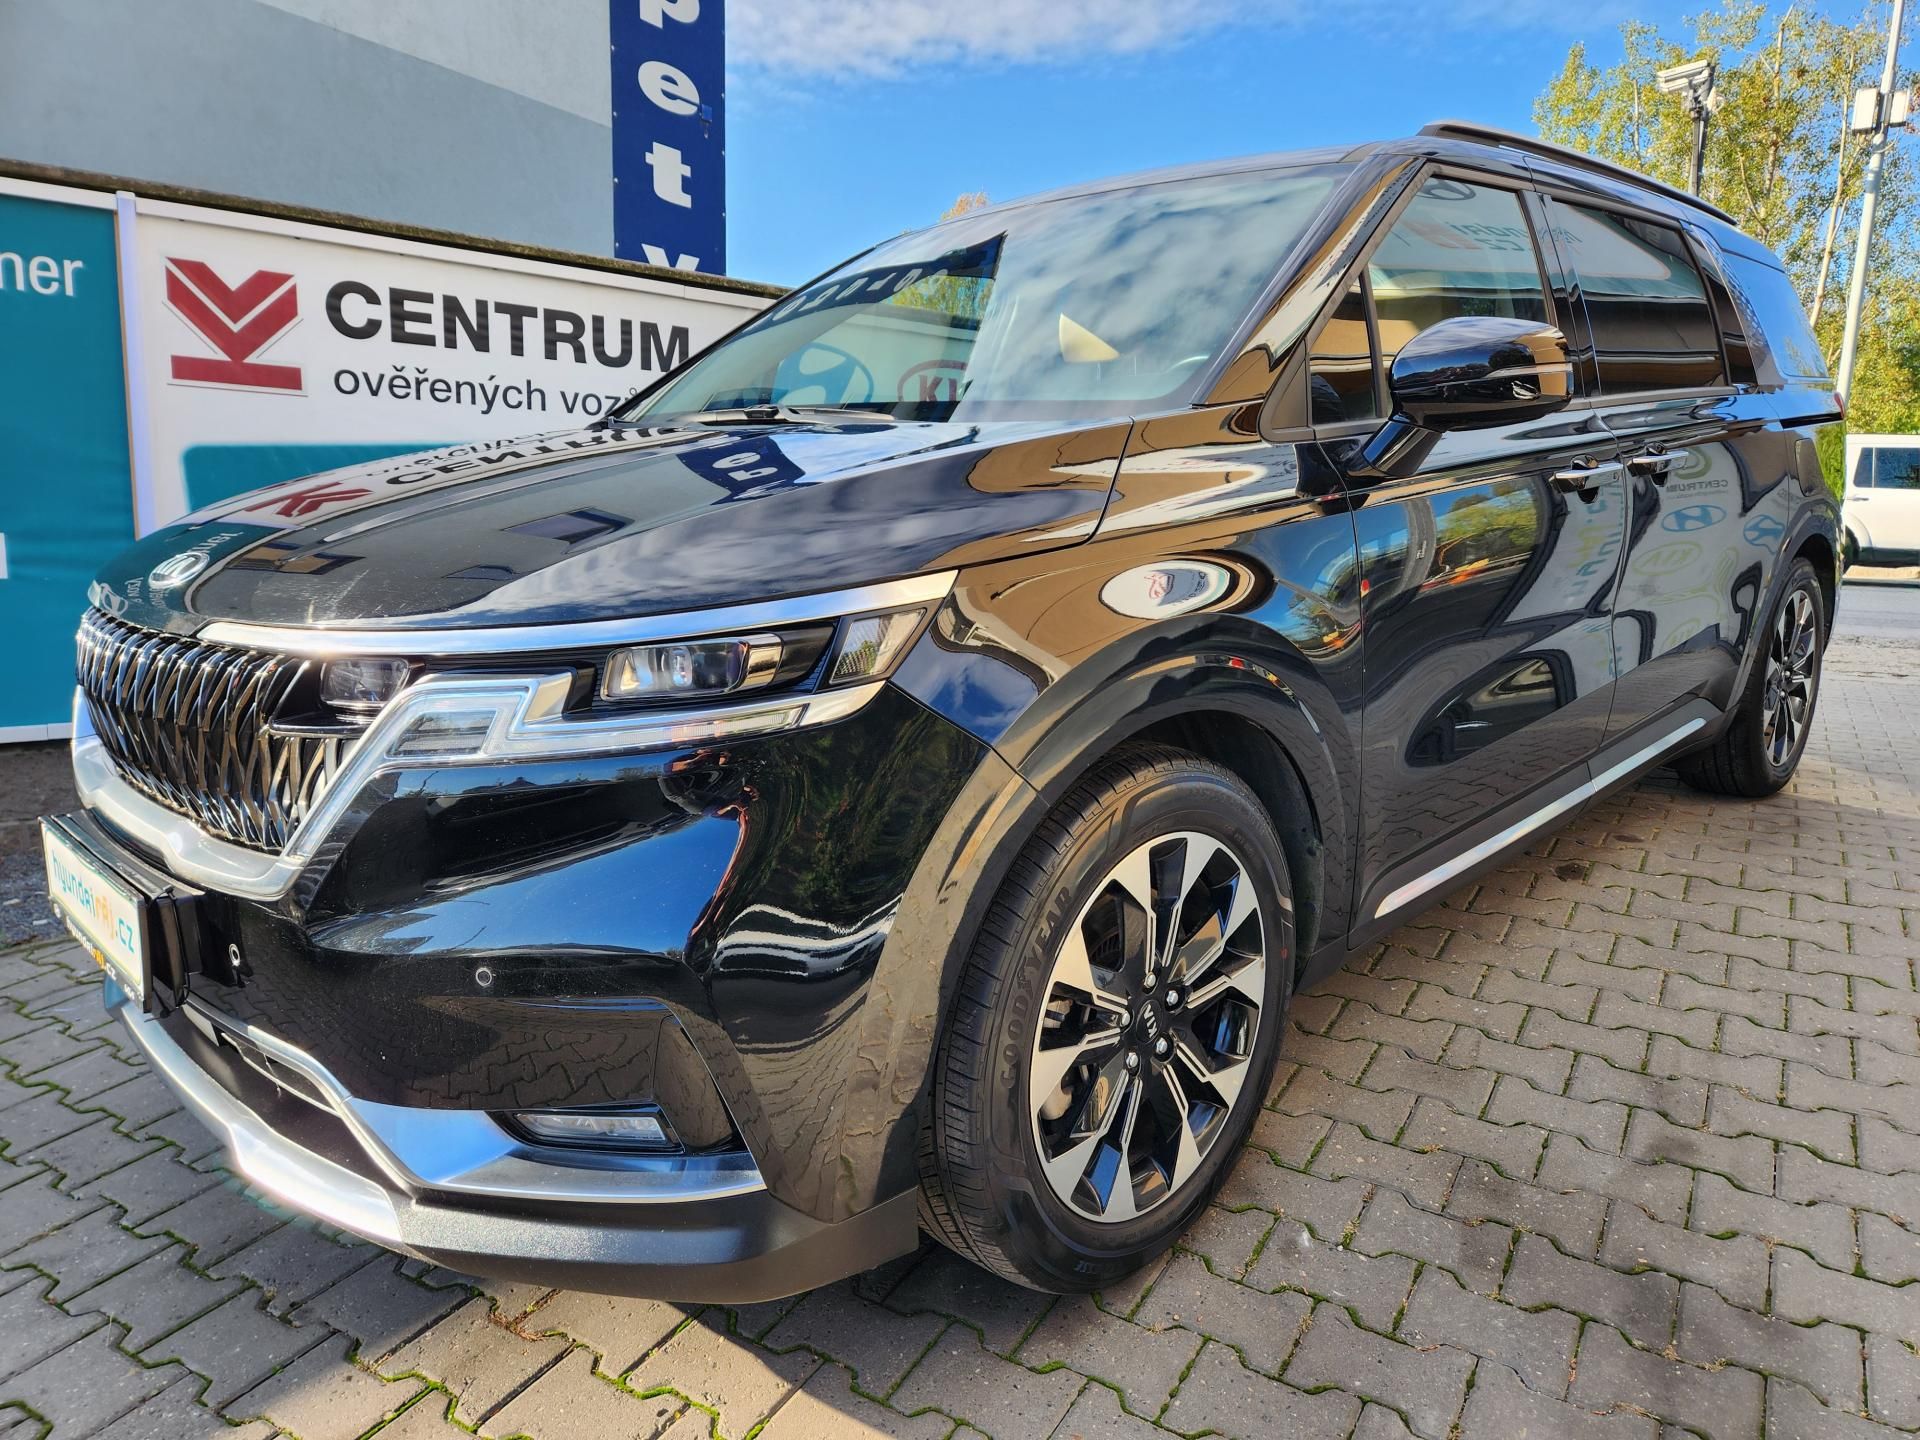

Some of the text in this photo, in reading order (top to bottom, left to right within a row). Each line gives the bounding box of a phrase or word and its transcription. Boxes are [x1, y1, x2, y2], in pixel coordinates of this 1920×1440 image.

[325, 280, 689, 373] CENTRUM
[333, 364, 638, 416] ověřených voz
[1001, 886, 1073, 1088] GOODYEAR
[1143, 1003, 1158, 1039] KIA
